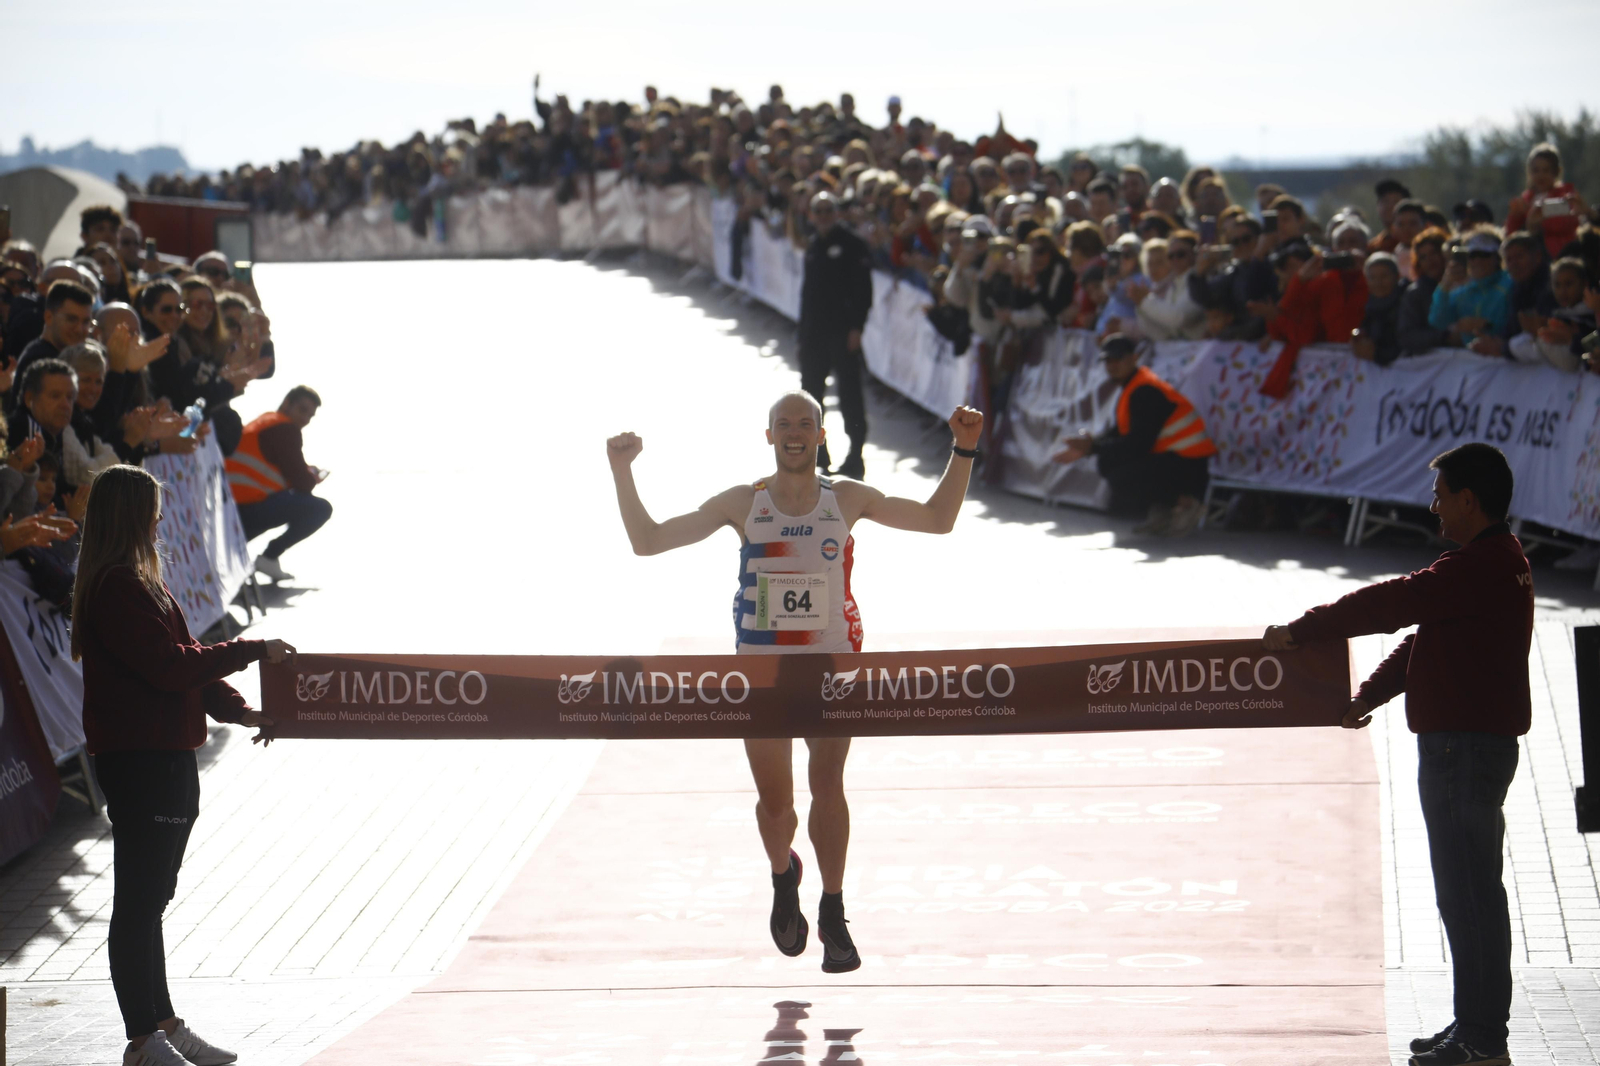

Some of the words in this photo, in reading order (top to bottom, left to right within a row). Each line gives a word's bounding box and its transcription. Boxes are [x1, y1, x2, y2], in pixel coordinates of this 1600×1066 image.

[781, 524, 813, 536] aula
[783, 590, 812, 612] 64
[865, 664, 1015, 700] IMDECO
[1132, 656, 1283, 694] IMDECO
[340, 670, 488, 705] IMDECO
[602, 671, 750, 704] IMDECO
[822, 709, 861, 719] Instituto
[864, 708, 910, 720] Municipal
[913, 708, 926, 717] de
[928, 707, 972, 719] Deportes
[974, 706, 1016, 716] Córdoba
[1088, 703, 1127, 713] Instituto
[1130, 702, 1177, 714] Municipal
[1180, 701, 1192, 711] de
[1195, 700, 1240, 713] Deportes
[1242, 699, 1284, 710] Córdoba
[298, 711, 336, 721] Instituto
[338, 712, 385, 724] Municipal
[388, 712, 400, 721] de
[402, 712, 446, 724] Deportes
[448, 712, 488, 722] Córdoba
[559, 712, 598, 722] Instituto
[600, 712, 647, 724] Municipal
[650, 712, 662, 721] de
[664, 712, 708, 724] Deportes
[710, 711, 751, 721] Córdoba
[853, 746, 1224, 768] IMDECO
[857, 801, 1222, 819] MDECO
[1105, 899, 1250, 912] 2022
